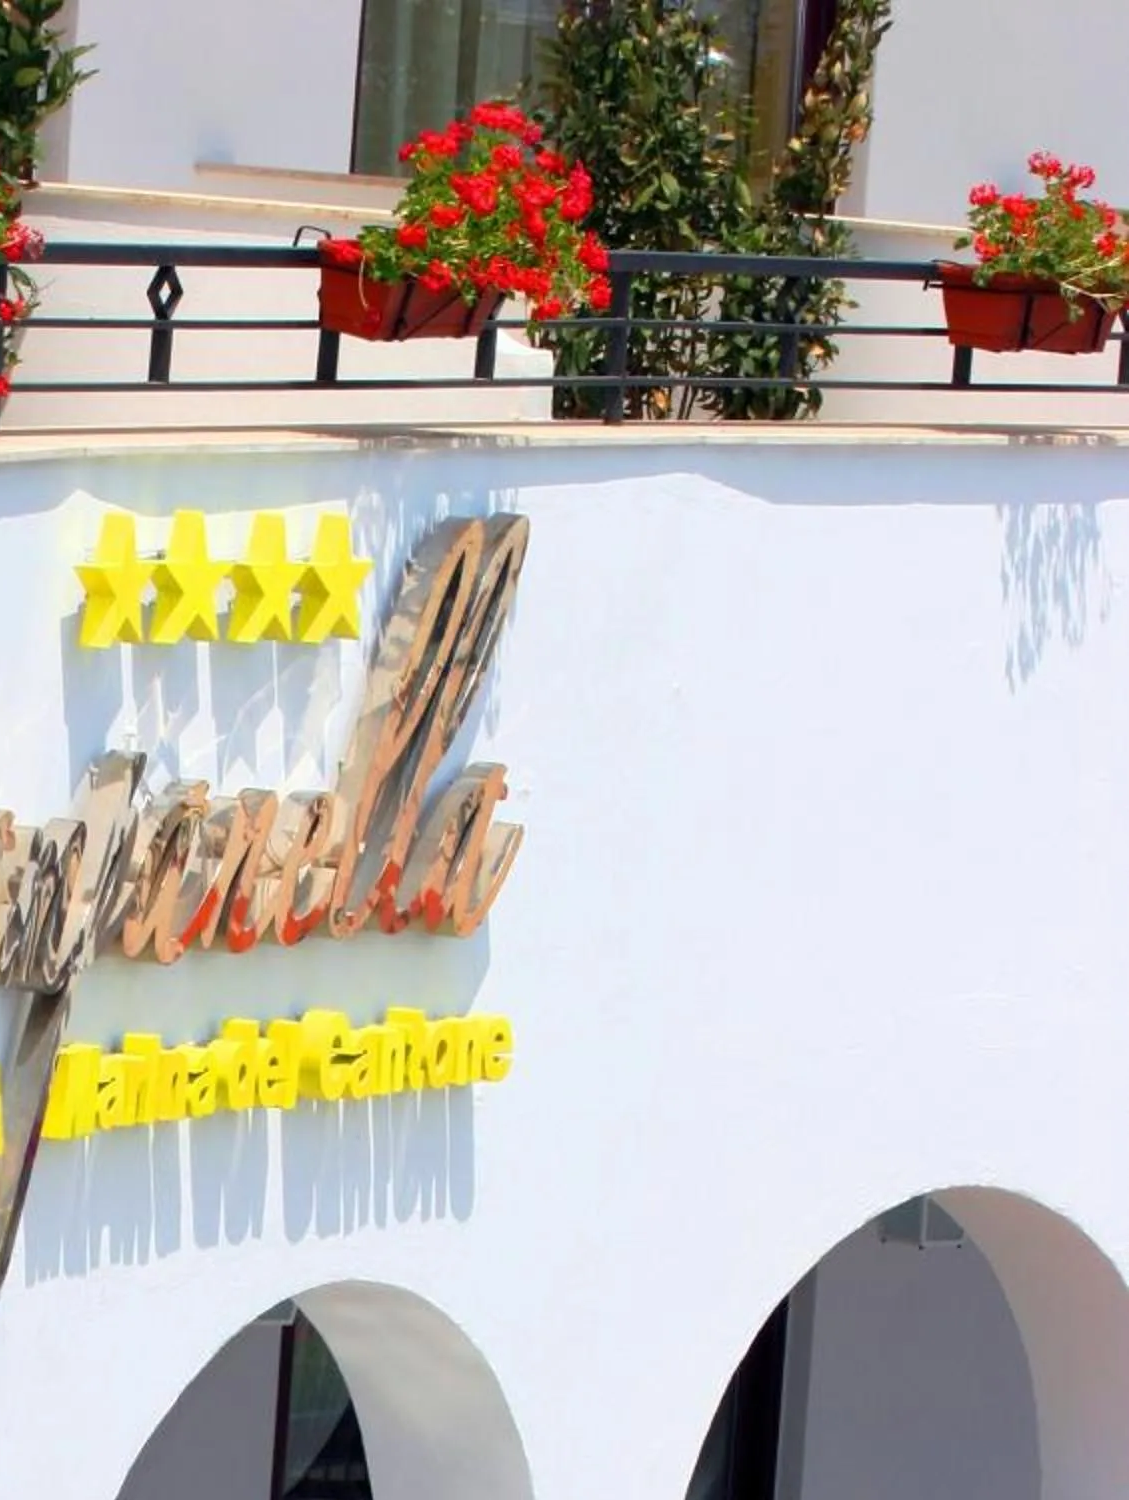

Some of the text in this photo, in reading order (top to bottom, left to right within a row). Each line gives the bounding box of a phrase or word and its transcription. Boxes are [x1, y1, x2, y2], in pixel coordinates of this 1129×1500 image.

[41, 1007, 515, 1140] Marina del Cantone
